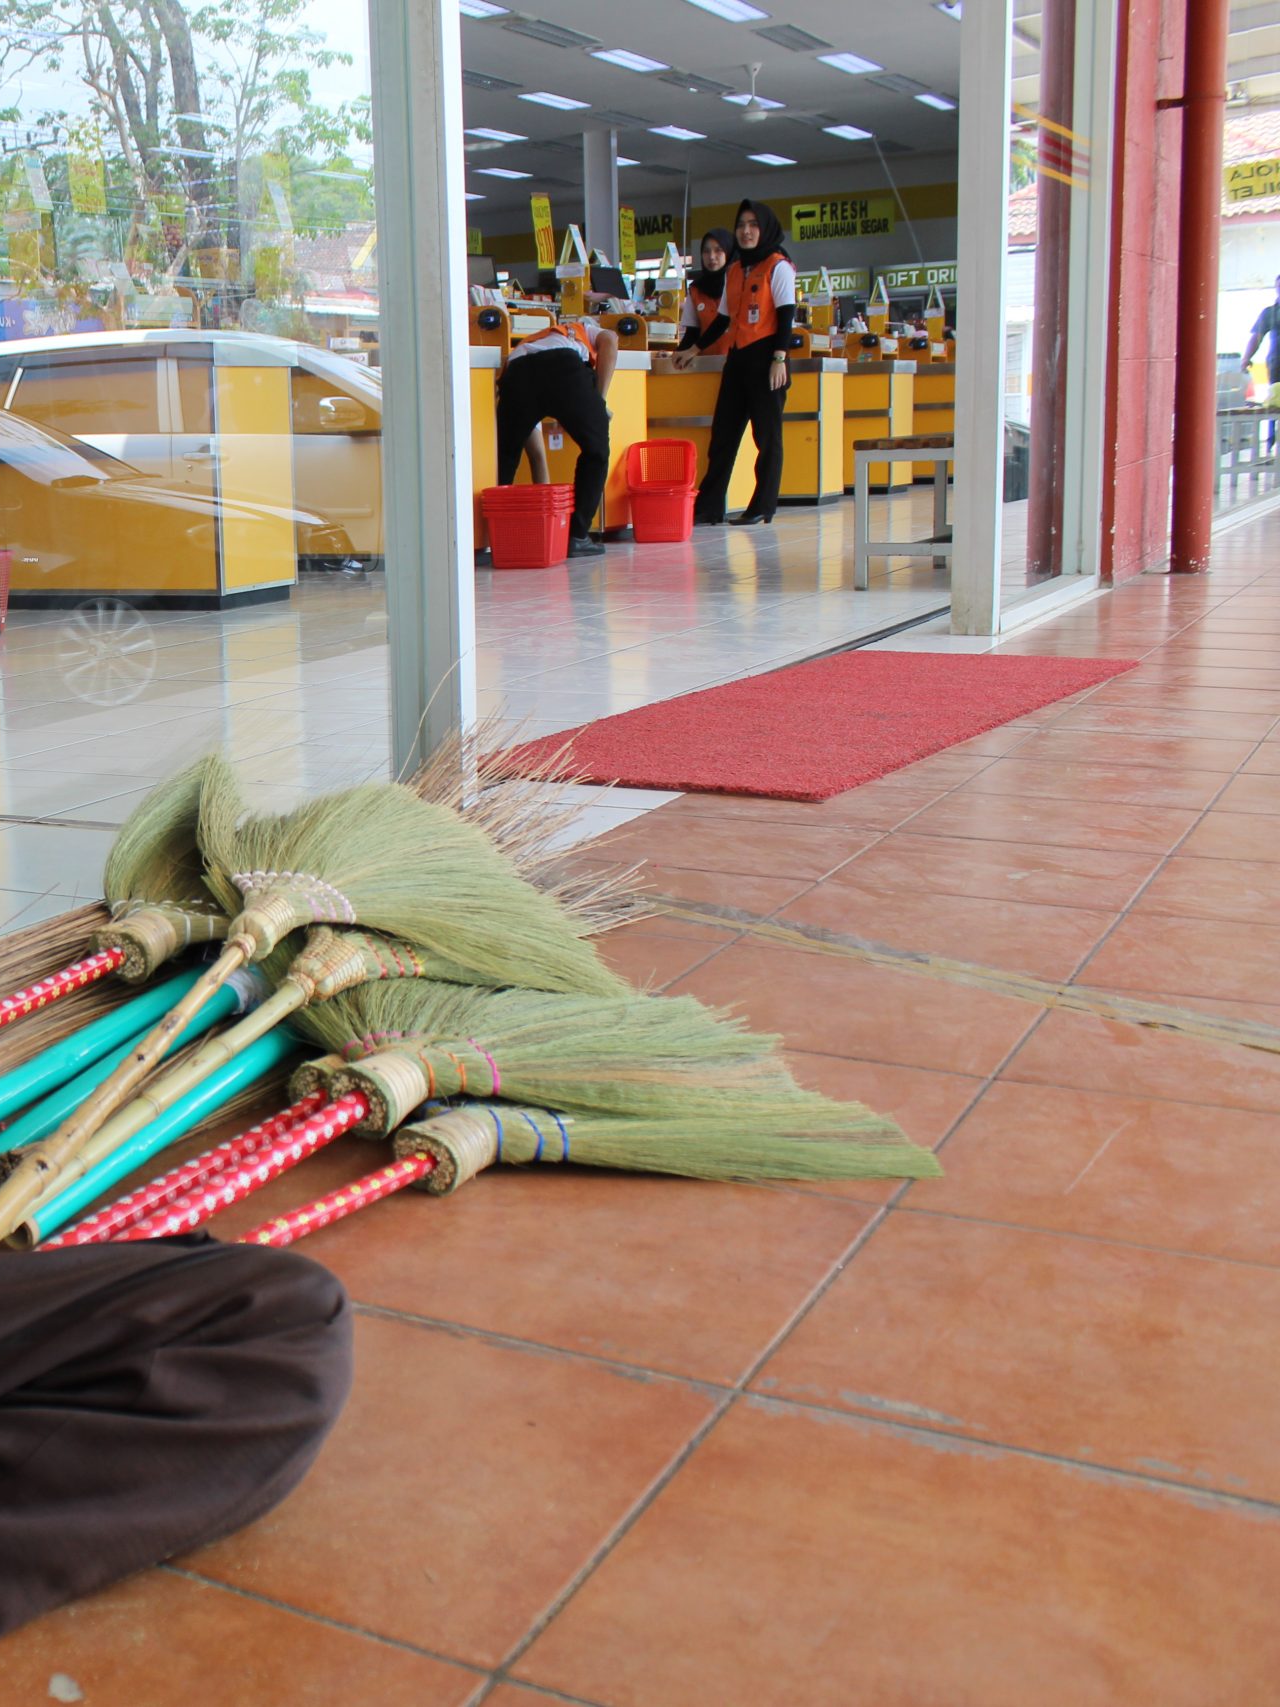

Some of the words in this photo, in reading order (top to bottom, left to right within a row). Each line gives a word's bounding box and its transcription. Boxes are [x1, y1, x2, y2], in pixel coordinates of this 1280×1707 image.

[820, 200, 868, 222] FRESH
[861, 218, 889, 235] SEGAR
[887, 271, 919, 287] OFT
[927, 268, 958, 284] DRI
